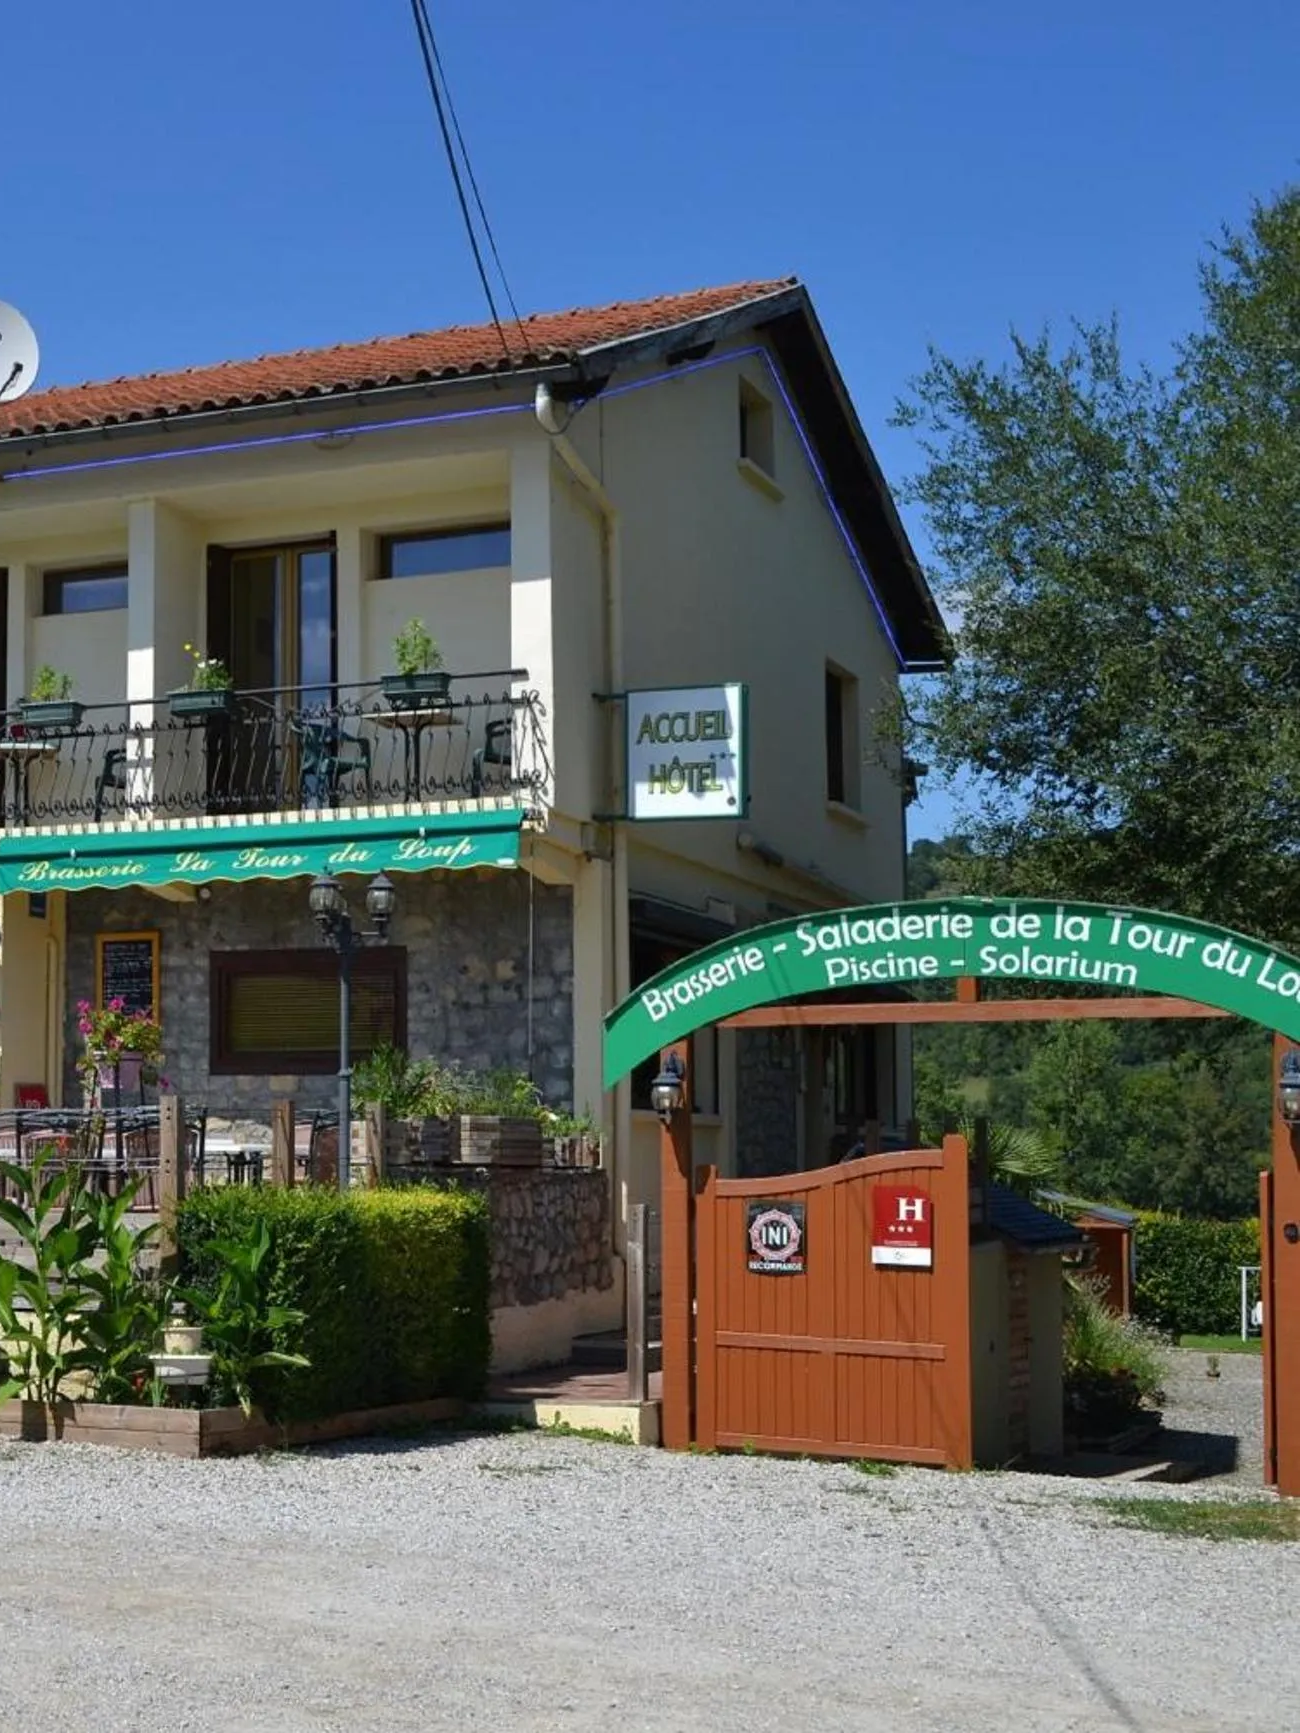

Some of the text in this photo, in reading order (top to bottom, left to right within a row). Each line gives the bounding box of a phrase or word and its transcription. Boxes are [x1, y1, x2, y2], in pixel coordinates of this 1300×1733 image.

[636, 710, 732, 745] ACCUEIL
[648, 754, 723, 795] HÔTEL
[18, 836, 478, 882] Brasserie La Tour du Loup
[640, 946, 765, 1022] Brasserie
[796, 905, 973, 957] Saladerie
[990, 902, 1041, 939] de
[1054, 905, 1091, 942] la
[1106, 910, 1196, 959] Tour
[1202, 937, 1252, 978] du
[1256, 951, 1300, 1004] Lo
[824, 952, 939, 985] Piscine
[979, 945, 1137, 986] Solarium
[895, 1197, 926, 1221] H
